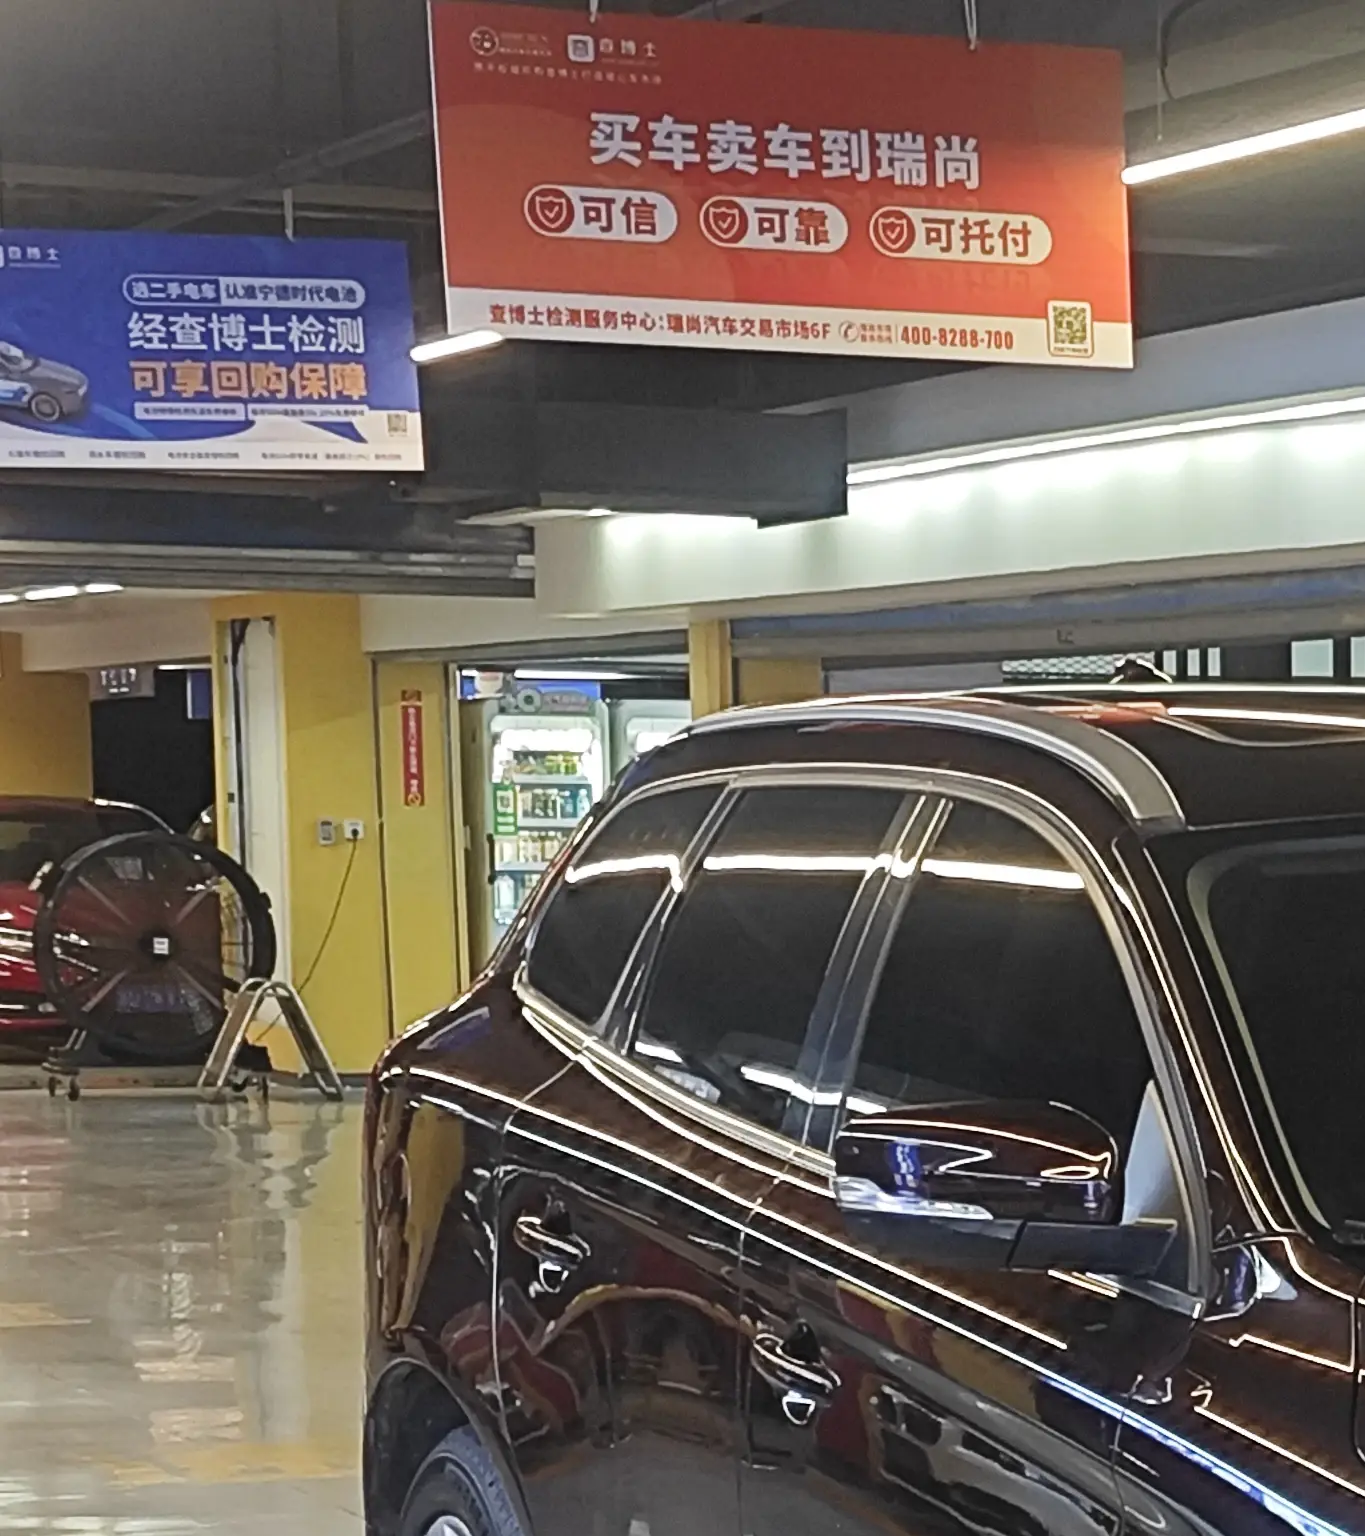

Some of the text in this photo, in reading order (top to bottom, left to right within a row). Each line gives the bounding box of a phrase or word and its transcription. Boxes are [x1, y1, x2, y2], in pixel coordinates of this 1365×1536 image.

[590, 112, 981, 190] 买车卖车到瑞尚
[581, 196, 1034, 258] 可信 可靠 可托付
[224, 283, 358, 304] 认准宁德时代电池
[127, 311, 365, 355] 经查博士检测
[901, 326, 1014, 350] 400-8288-700
[129, 359, 369, 400] 可享回购保障
